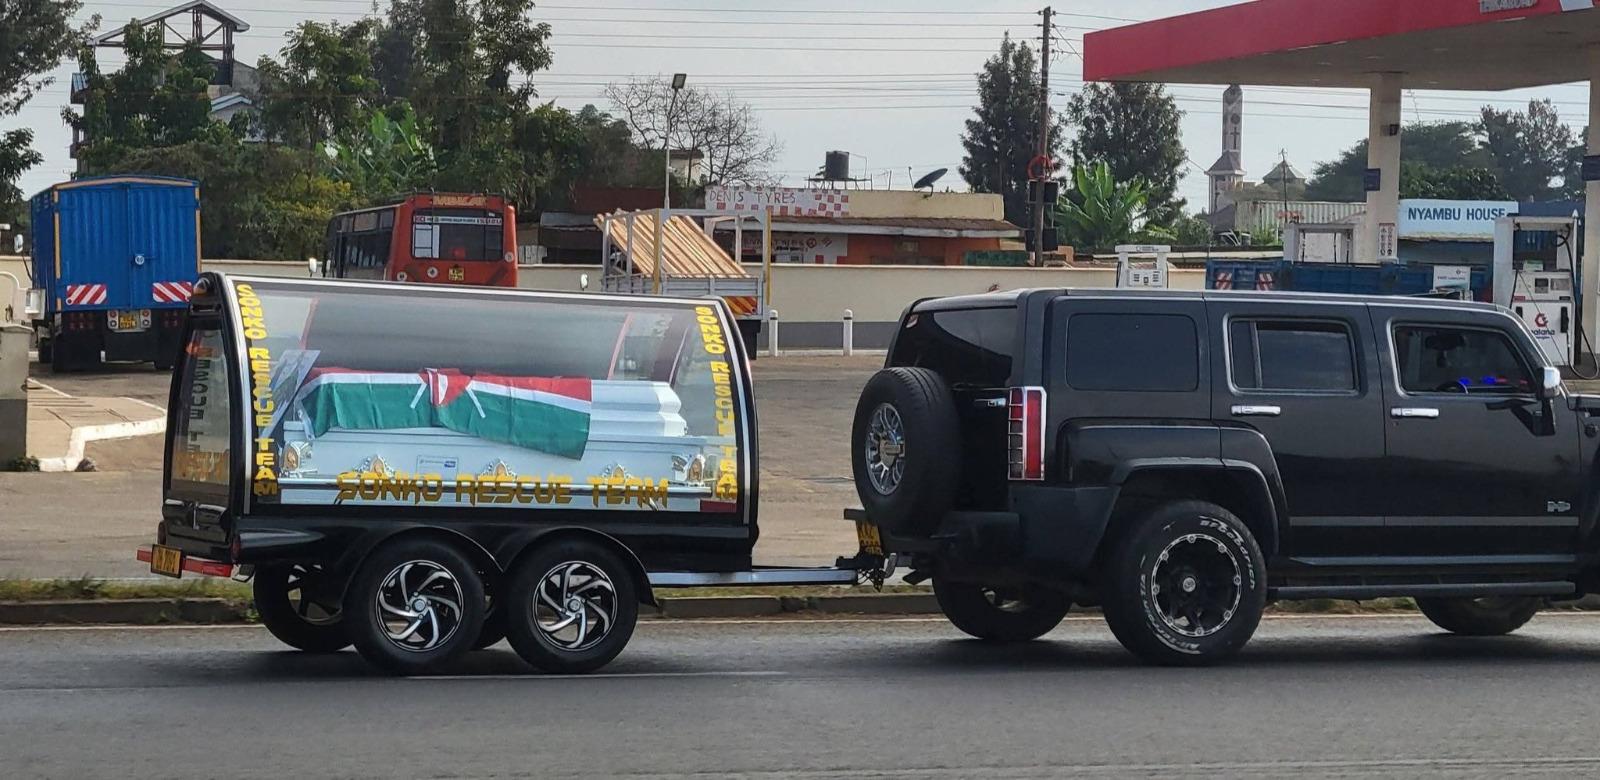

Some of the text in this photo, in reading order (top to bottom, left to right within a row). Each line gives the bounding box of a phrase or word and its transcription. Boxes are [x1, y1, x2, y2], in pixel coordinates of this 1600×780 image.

[710, 190, 796, 204] DENIS TYRES
[1408, 207, 1506, 221] NYAMBU HOUSE
[236, 284, 278, 496] SONKO RESCUE TEAM
[695, 306, 738, 499] SONKO RESCUE TEAM
[335, 472, 669, 509] SONKO RESCUE TEAM
